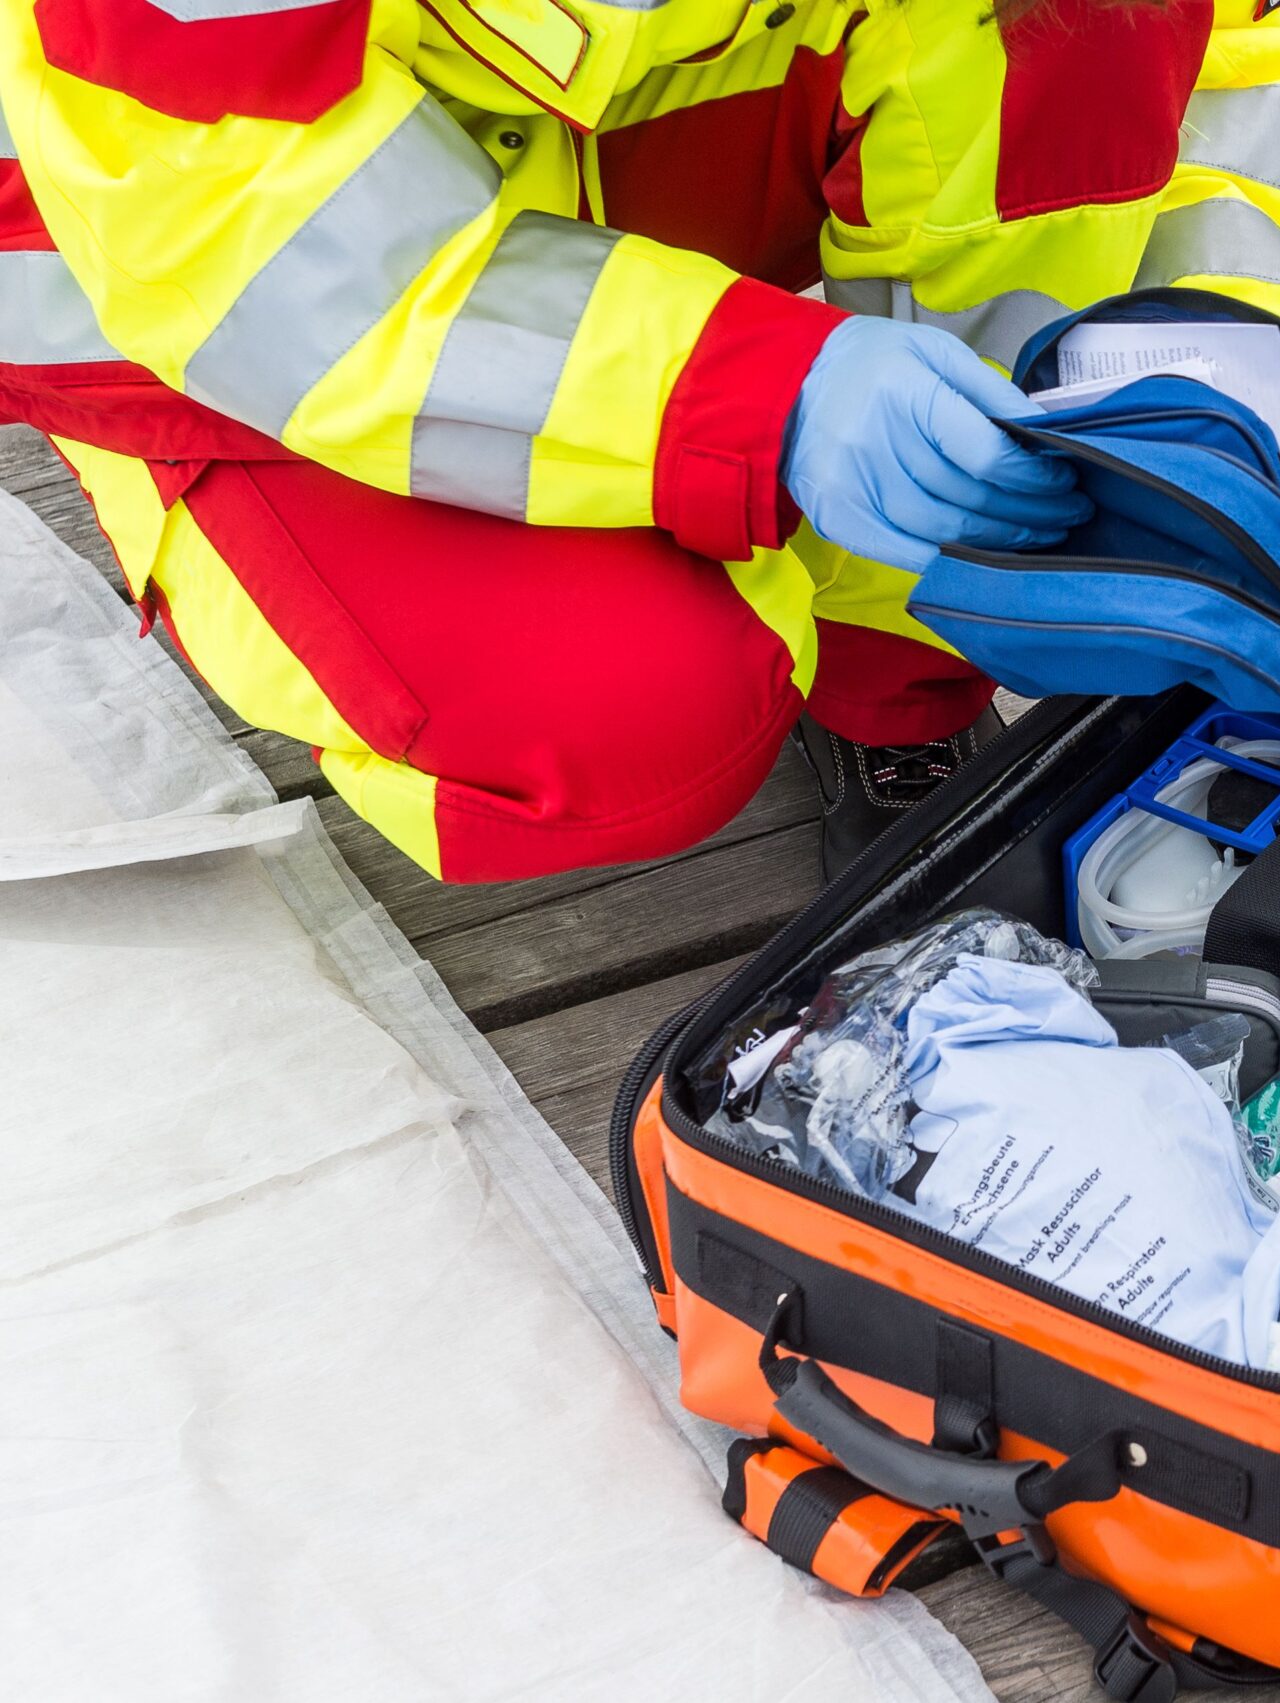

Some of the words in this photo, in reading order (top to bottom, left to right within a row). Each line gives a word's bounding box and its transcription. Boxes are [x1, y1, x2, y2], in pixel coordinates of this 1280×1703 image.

[1014, 1237, 1046, 1270] Mask
[1041, 1168, 1102, 1238] Resuscitator
[1046, 1222, 1081, 1264] Adults
[1080, 1214, 1116, 1254] breathing
[1113, 1193, 1132, 1215] mask
[1118, 1275, 1155, 1310] Adulte
